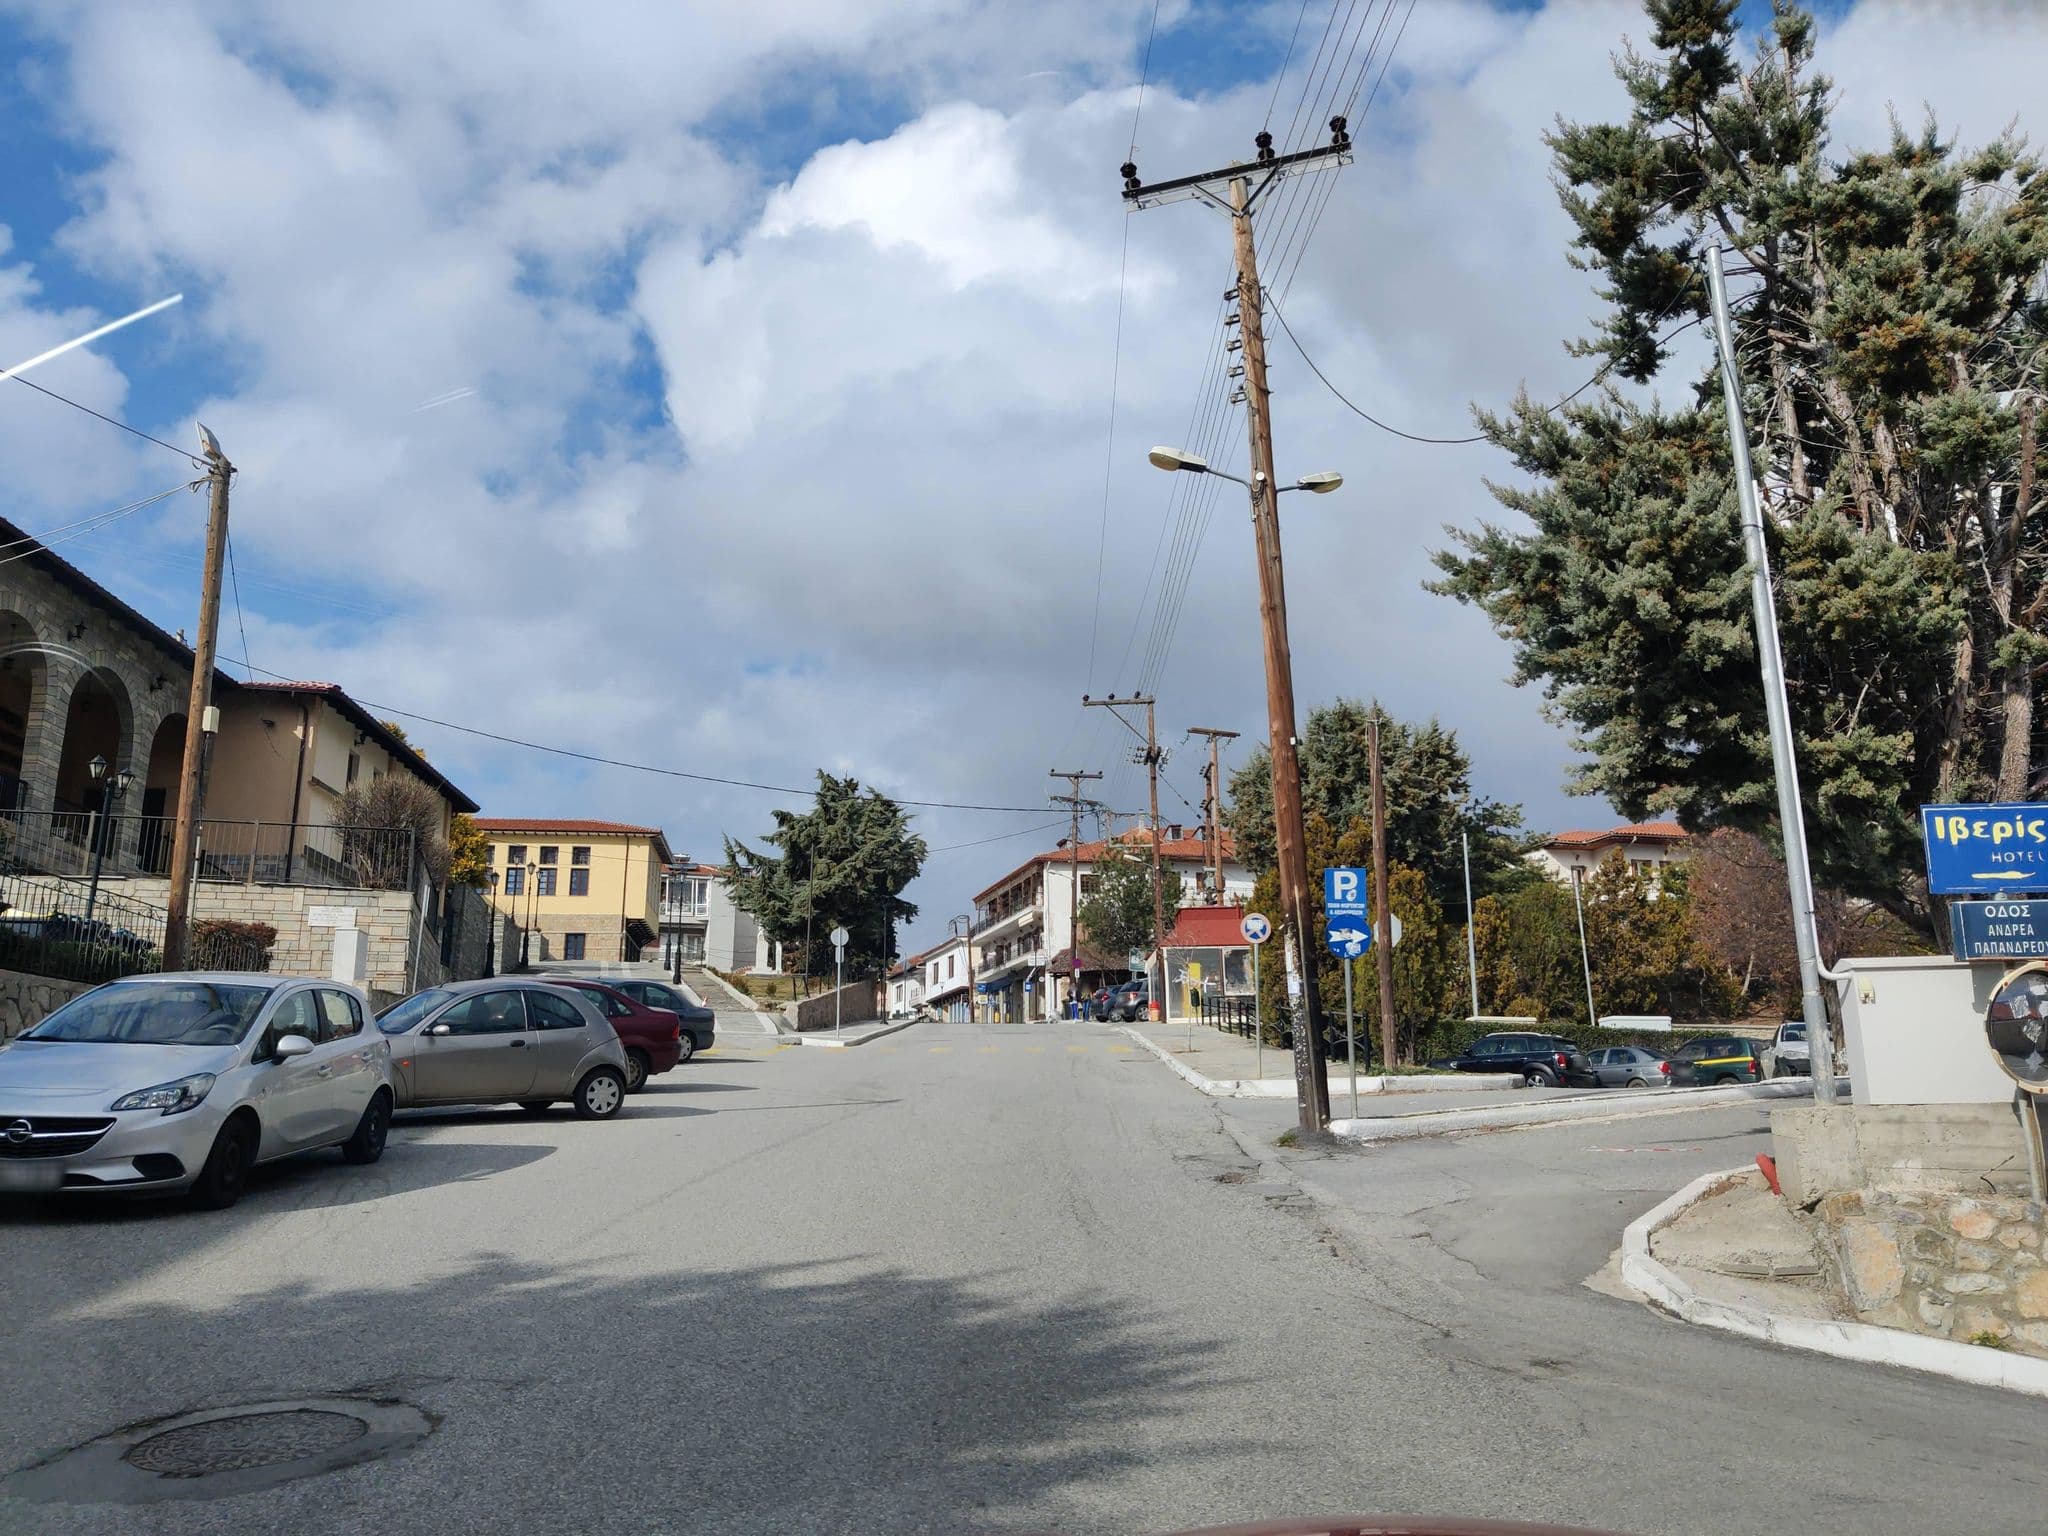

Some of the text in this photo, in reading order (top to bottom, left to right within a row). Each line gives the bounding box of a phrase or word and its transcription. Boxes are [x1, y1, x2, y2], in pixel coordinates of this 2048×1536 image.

[1934, 815, 2047, 845] Ιβερίς
[1991, 851, 2045, 863] HOTEL
[1984, 905, 2031, 918] ΟΔΟΣ
[1988, 923, 2035, 937] ΑΝΔΡΕΑ
